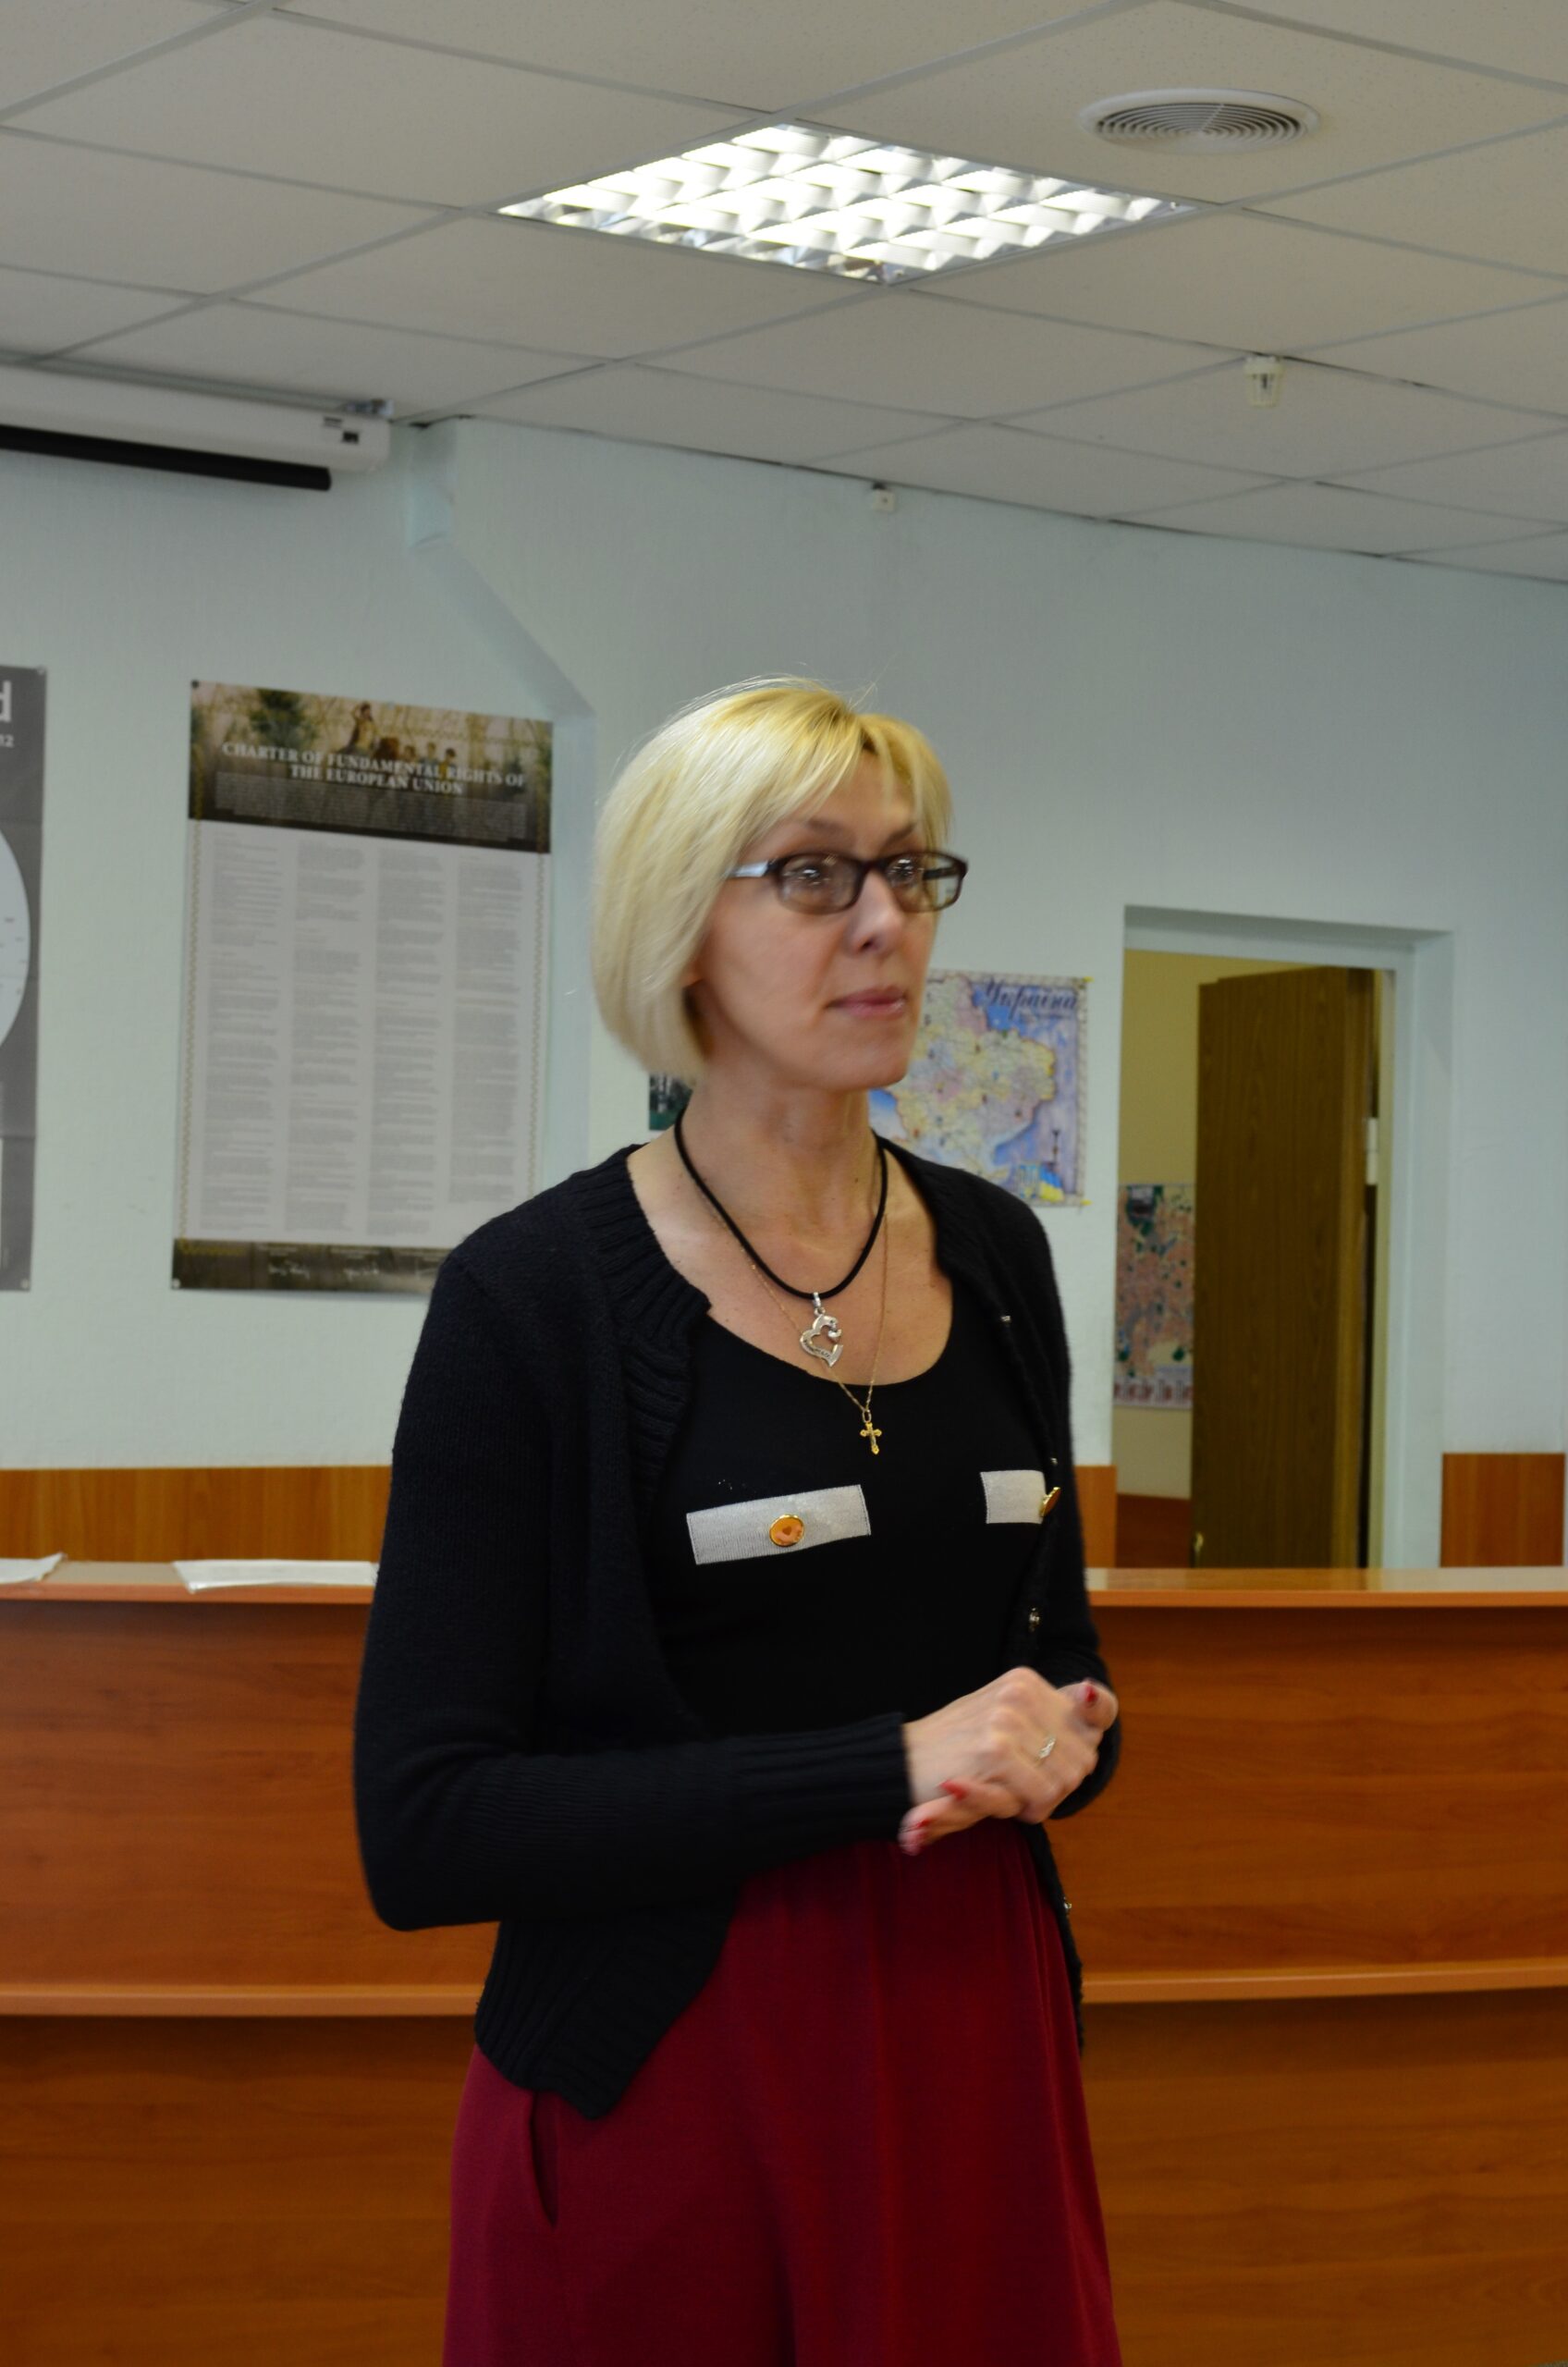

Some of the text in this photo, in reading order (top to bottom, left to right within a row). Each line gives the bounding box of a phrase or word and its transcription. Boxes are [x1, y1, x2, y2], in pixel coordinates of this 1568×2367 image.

[222, 742, 526, 788] CHARTER OF FUNDAMENTAL RIGHTS OF
[290, 764, 463, 796] THE EUROPEAN UNION
